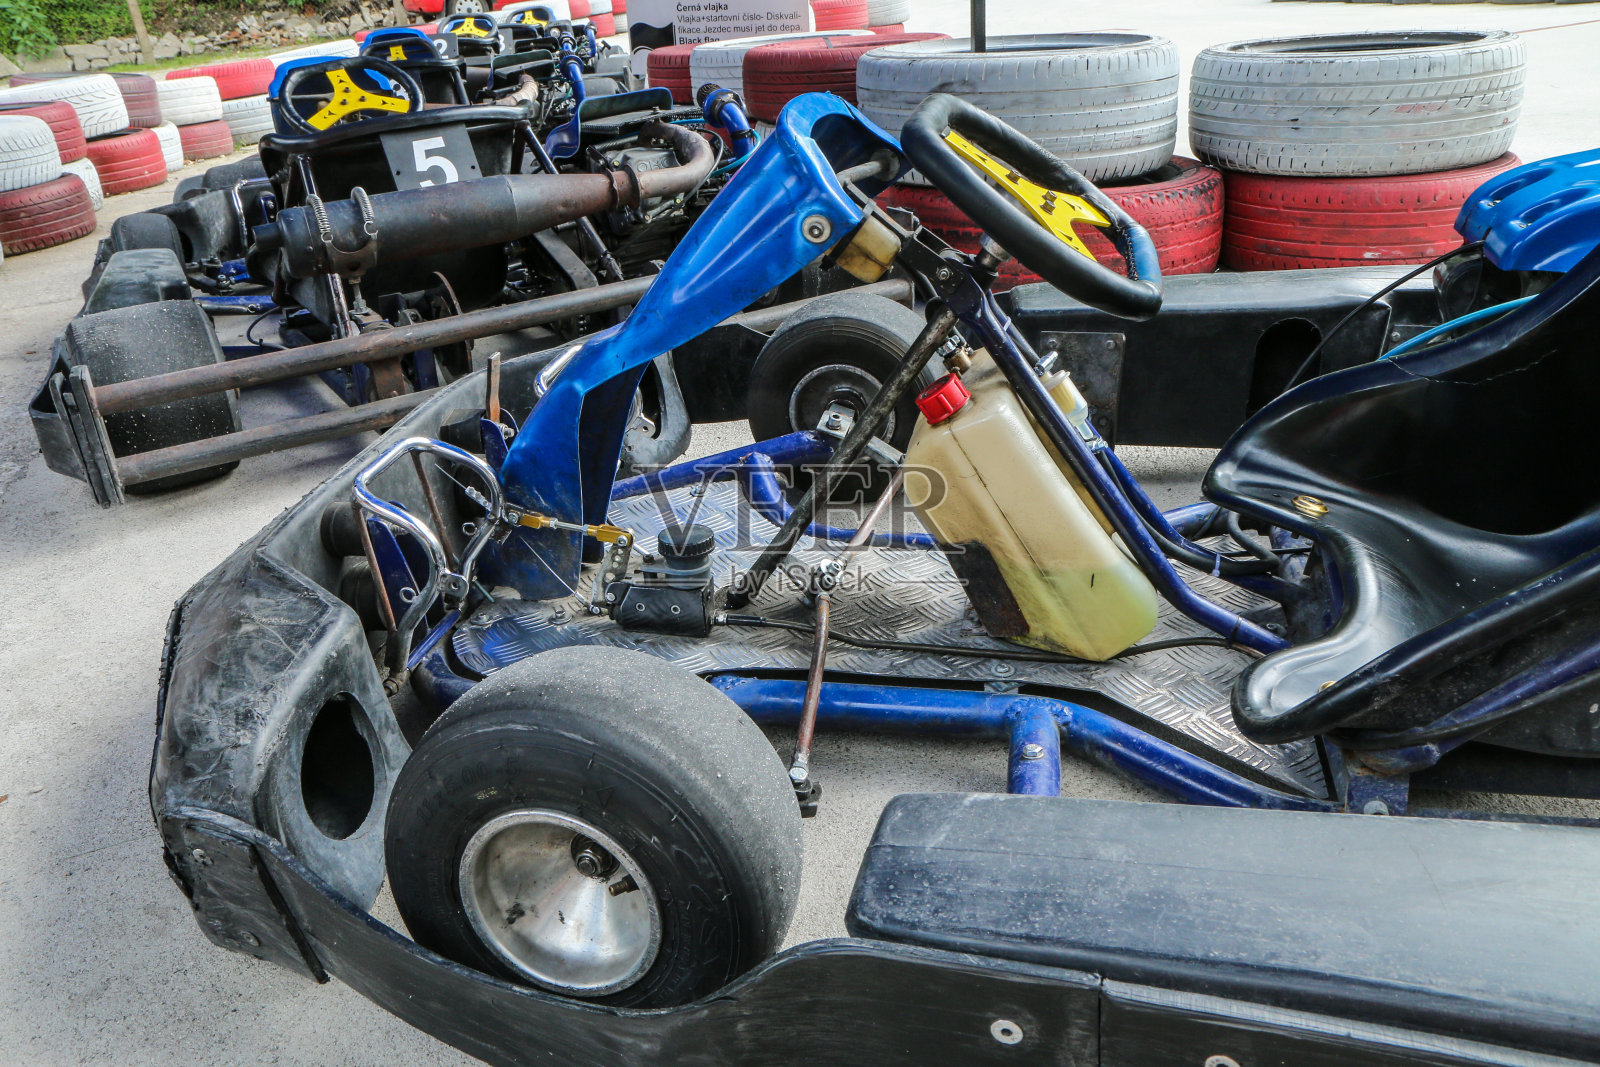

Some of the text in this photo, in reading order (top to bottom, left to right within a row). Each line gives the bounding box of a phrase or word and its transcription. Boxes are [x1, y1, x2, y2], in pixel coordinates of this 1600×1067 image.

[676, 2, 728, 13] Černá vlajka
[754, 23, 765, 34] jet
[767, 23, 778, 32] do
[679, 36, 702, 45] Black
[412, 136, 459, 188] 5
